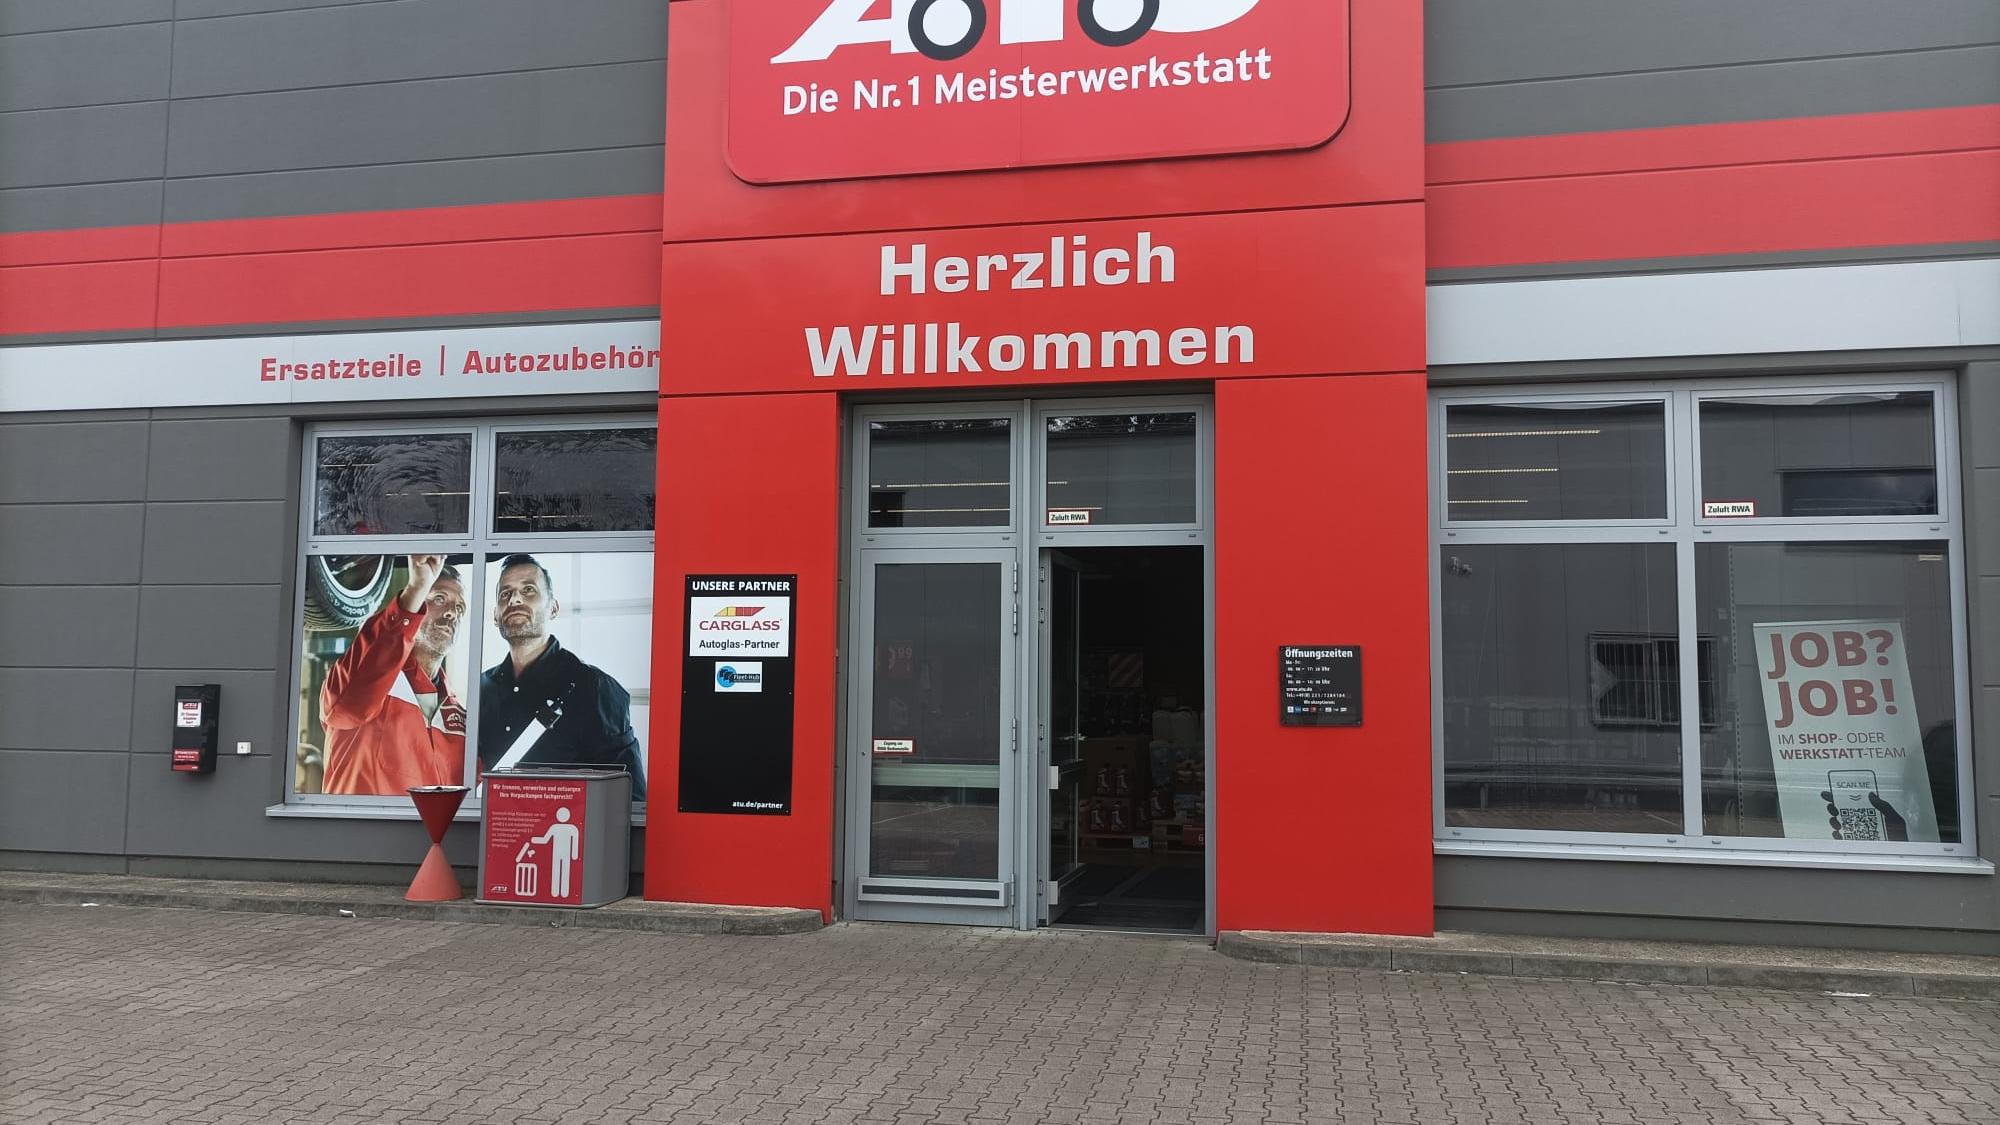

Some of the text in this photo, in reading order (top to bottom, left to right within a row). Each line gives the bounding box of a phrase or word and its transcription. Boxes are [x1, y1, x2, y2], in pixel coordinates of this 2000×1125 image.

[783, 82, 839, 116] Die
[934, 47, 1272, 104] Meisterwerkstatt
[880, 231, 1175, 295] Herzlich
[805, 322, 1255, 377] Willkommen
[260, 345, 660, 382] Ersatzteile Autozubehör
[1707, 505, 1750, 513] Zuluft RWA
[692, 580, 790, 592] UNSERE PARTNER
[699, 620, 780, 631] CARGLASS
[699, 639, 780, 650] Autoglas-Partner
[1285, 647, 1353, 660] Öffnungszeiten
[1767, 629, 1894, 679] JOB?
[1775, 679, 1898, 729] JOB!
[1778, 733, 1886, 745] IM SHOP- ODER
[1780, 747, 1906, 760] WERKSTATT-TEAM
[732, 801, 784, 810] atu.de/partner
